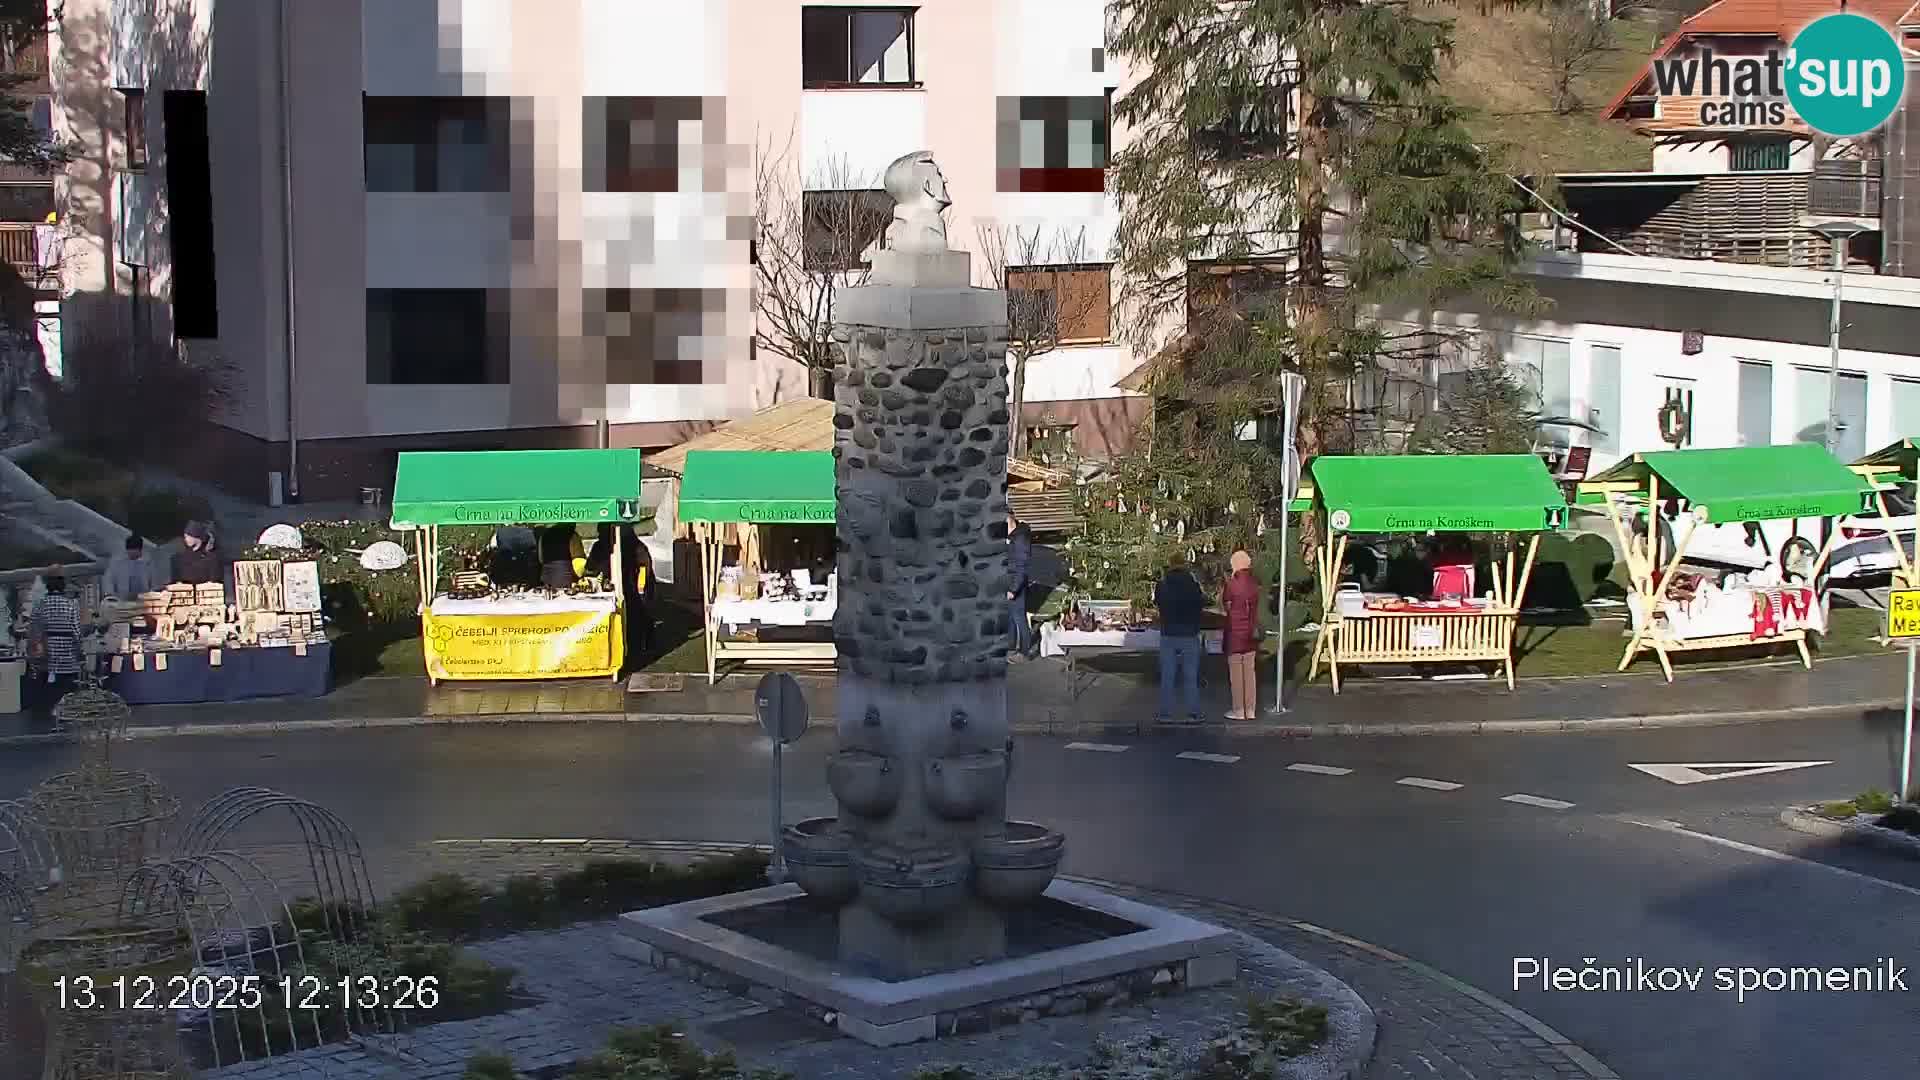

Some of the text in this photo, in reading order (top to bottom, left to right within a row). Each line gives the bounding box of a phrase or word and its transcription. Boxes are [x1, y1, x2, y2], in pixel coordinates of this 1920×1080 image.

[455, 502, 591, 521] Črna na Koroškem
[739, 502, 775, 520] Črna
[780, 509, 798, 520] na
[1386, 513, 1495, 528] Črna na Koroškem
